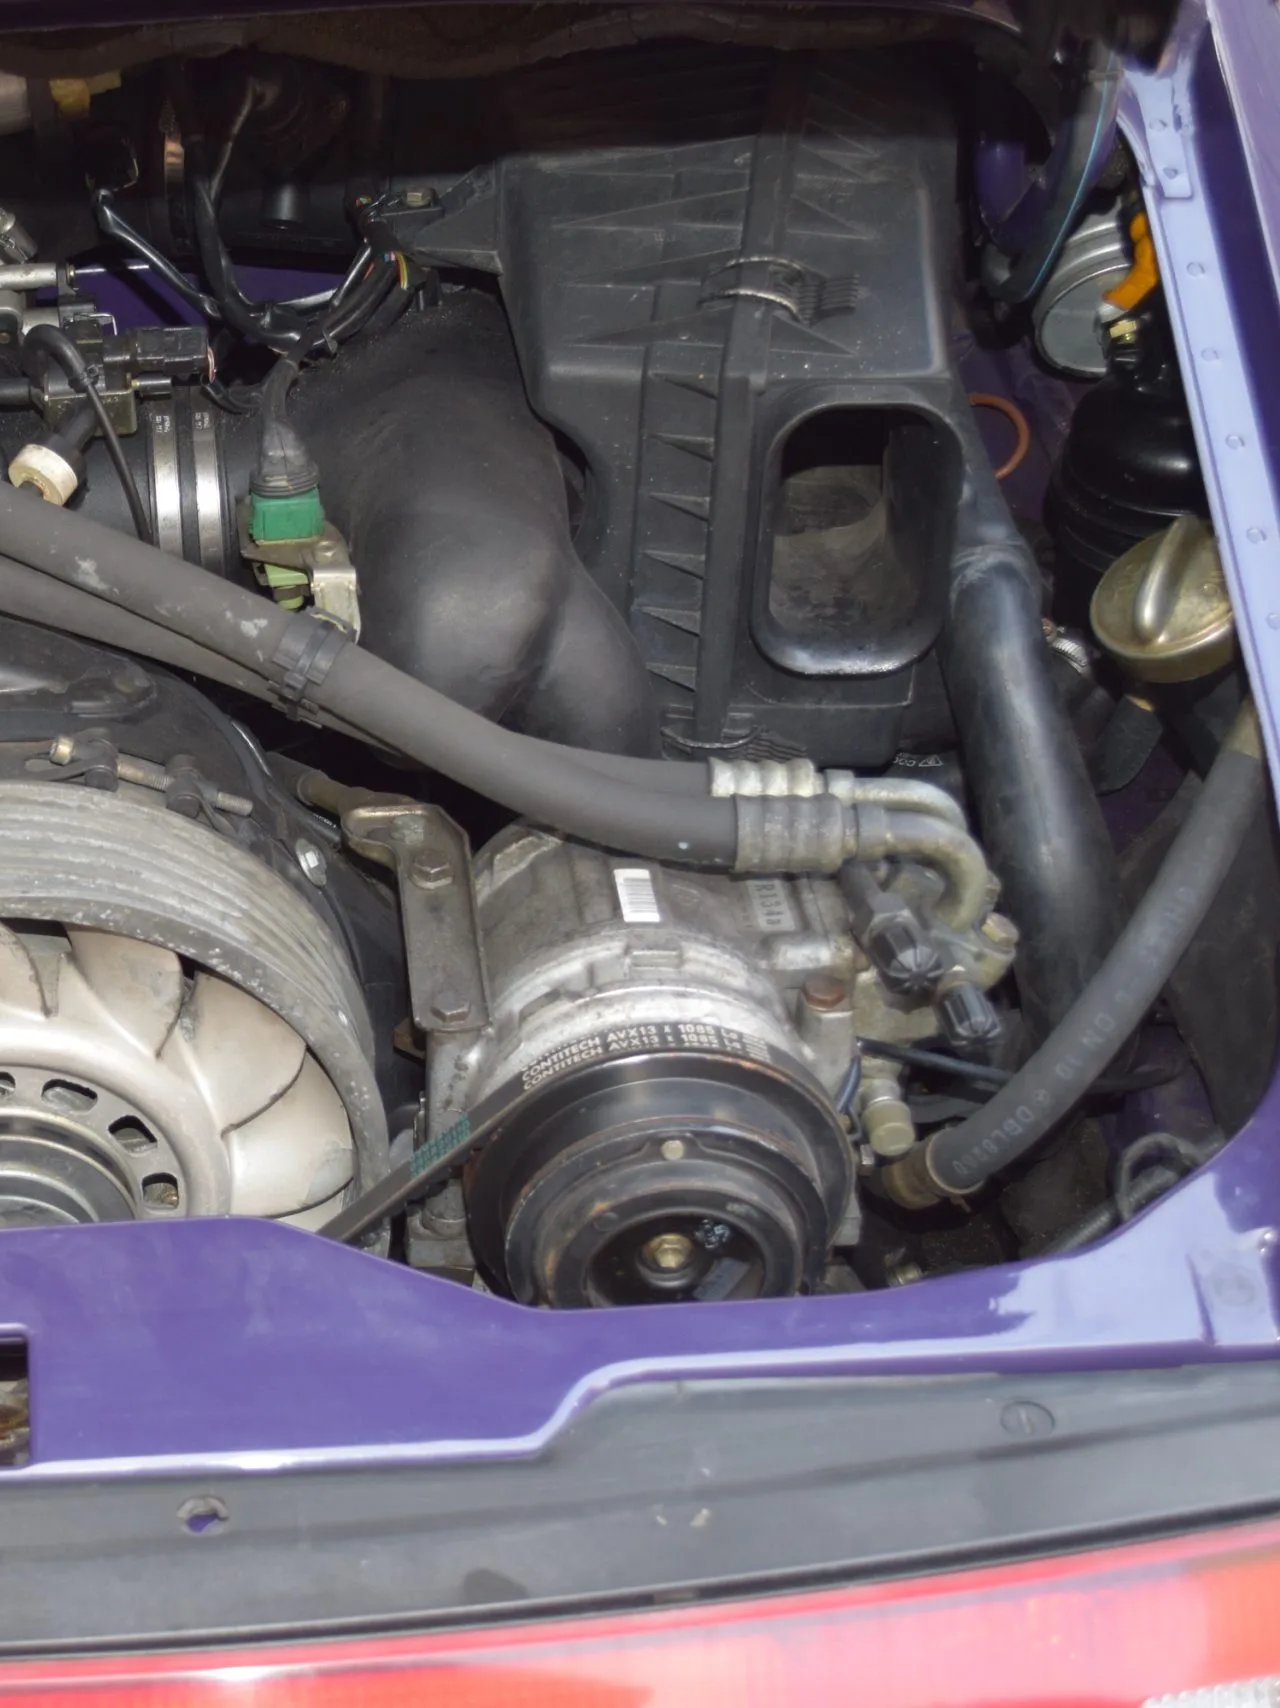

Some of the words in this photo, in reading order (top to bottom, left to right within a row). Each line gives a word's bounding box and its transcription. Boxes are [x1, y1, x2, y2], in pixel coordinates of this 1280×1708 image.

[521, 1036, 600, 1082] CONTITECH
[607, 1024, 657, 1042] AVX13
[523, 1046, 603, 1090] CONTITECH
[610, 1035, 660, 1051] AVX13
